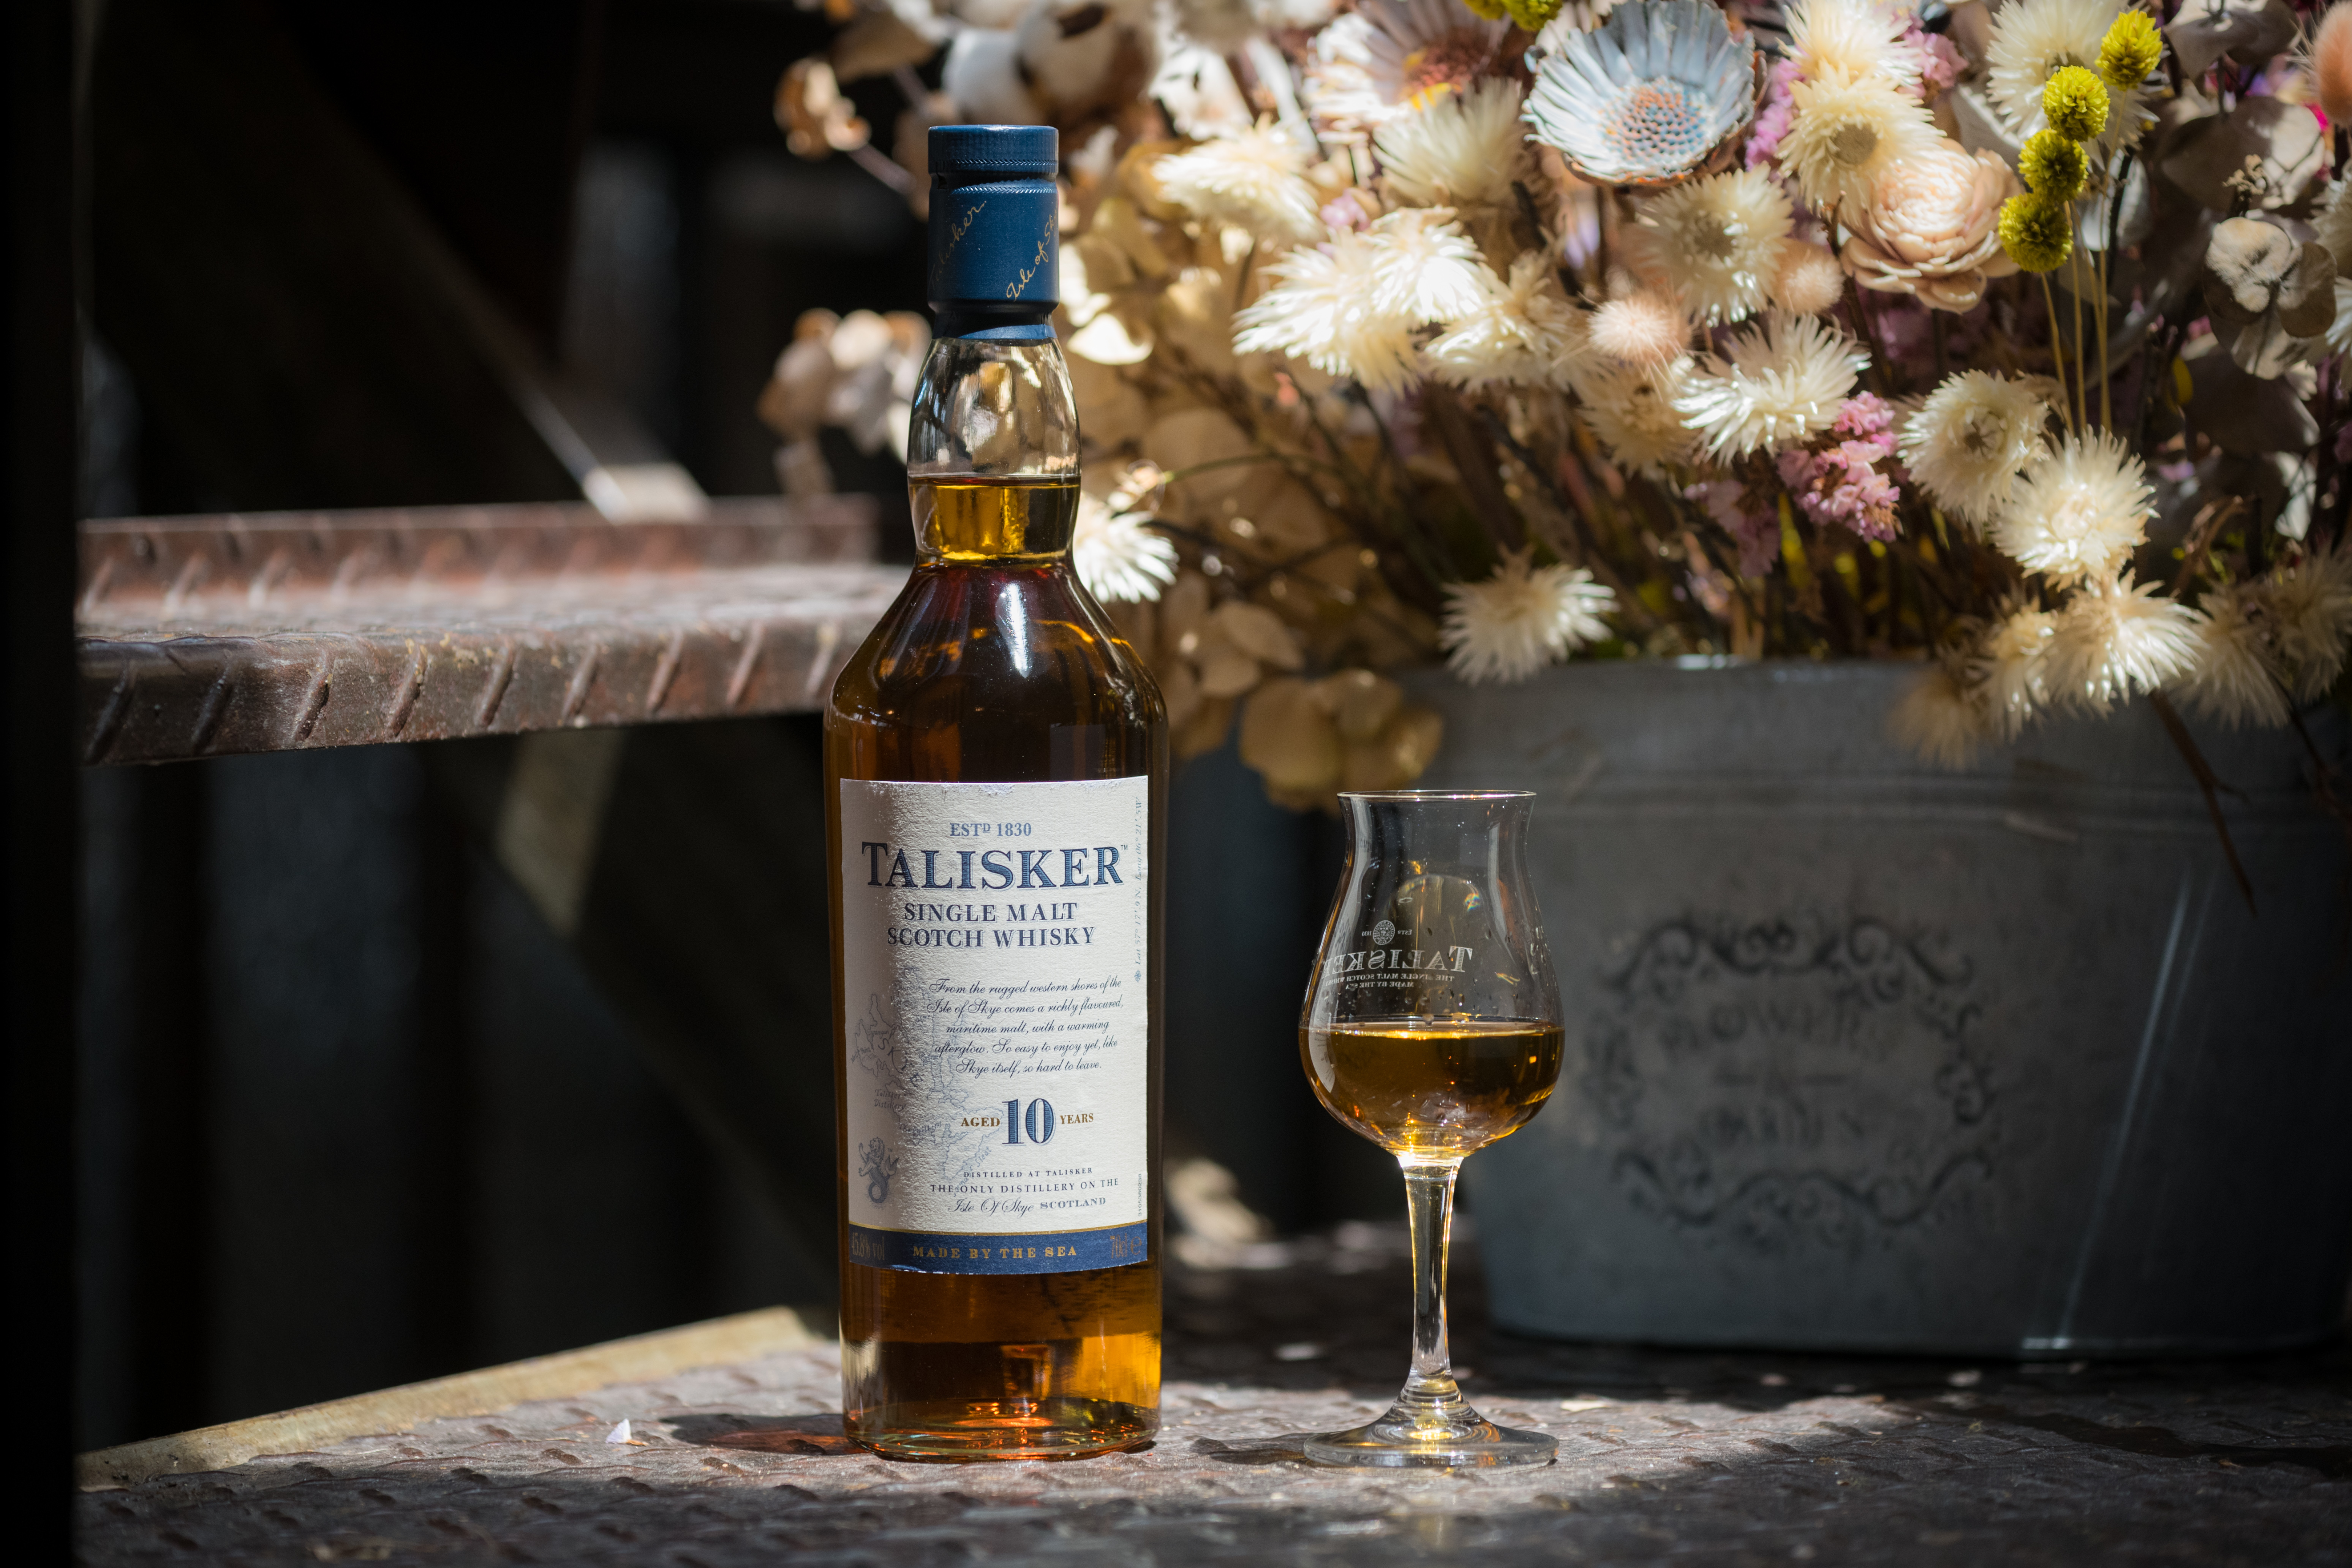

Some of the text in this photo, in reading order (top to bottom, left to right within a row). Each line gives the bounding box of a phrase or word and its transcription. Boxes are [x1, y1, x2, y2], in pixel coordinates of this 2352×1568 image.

[1006, 266, 1036, 302] Isle
[1035, 241, 1049, 265] of
[997, 823, 1032, 836] 1830
[861, 841, 1124, 889] TALISKER
[904, 903, 1078, 922] SINGLE MALT
[887, 926, 1095, 948] SCOTCH WHISKY
[929, 978, 967, 993] From
[969, 981, 985, 993] the
[989, 980, 1030, 999] rugged
[1030, 982, 1068, 993] western
[1070, 978, 1097, 991] shores
[1100, 975, 1111, 994] of
[1110, 975, 1121, 988] the
[927, 998, 952, 1013] Isle
[955, 1000, 969, 1018] of
[968, 998, 1002, 1019] Skye
[1048, 999, 1078, 1016] richly
[1079, 994, 1123, 1015] flavoured,
[946, 1023, 997, 1033] maritime
[1000, 1020, 1029, 1035] malt,
[1032, 1020, 1055, 1032] with
[1067, 1019, 1110, 1034] warming
[935, 1040, 988, 1059] afterglow.
[992, 1038, 1012, 1053] So
[1015, 1045, 1038, 1058] easy
[1041, 1042, 1051, 1052] to
[1054, 1041, 1082, 1057] enjoy
[1083, 1039, 1100, 1056] yet,
[1103, 1035, 1118, 1048] like
[956, 1058, 989, 1079] Skye
[992, 1060, 1021, 1078] itself,
[1036, 1059, 1064, 1072] hard
[1065, 1061, 1073, 1070] to
[1076, 1057, 1102, 1070] leave.
[874, 1099, 907, 1112] Distillery
[875, 1089, 901, 1100] Talisker
[961, 1098, 1094, 1146] AGED 10 YEARS
[1046, 1168, 1092, 1176] TALISKER
[1001, 1183, 1075, 1193] DISTILLERY
[1081, 1181, 1095, 1189] ON
[1100, 1178, 1118, 1187] THE
[948, 1197, 1106, 1219] Isle Of Skye SCOTLAND
[872, 1236, 885, 1261] vol
[913, 1246, 1076, 1258] MADE BY THE SEA
